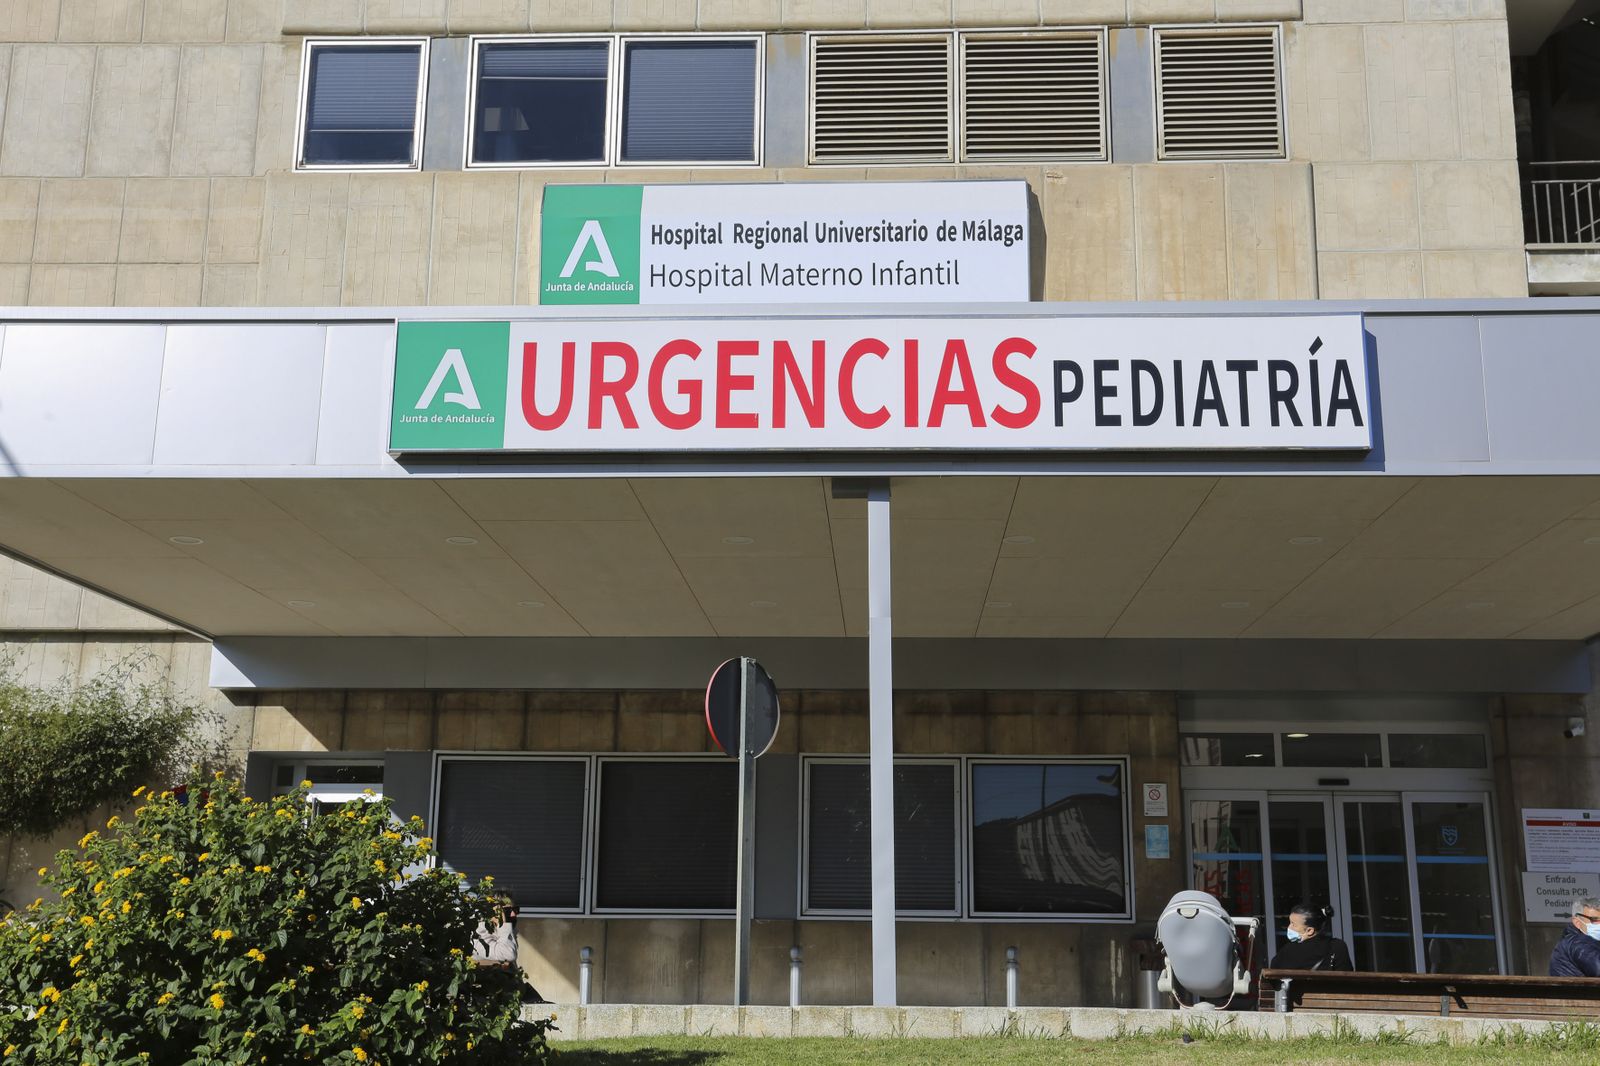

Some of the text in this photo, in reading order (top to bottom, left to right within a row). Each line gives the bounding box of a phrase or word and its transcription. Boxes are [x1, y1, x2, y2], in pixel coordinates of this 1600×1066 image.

[652, 219, 1024, 250] Hospital Regional Universitario de Málaga
[650, 260, 960, 294] Hospital Materno Infantil
[545, 281, 634, 293] Junta de Andalucía
[521, 336, 1364, 431] URGENCIAS PEDIATRÍA
[399, 413, 495, 425] Junta de Andalucía
[1545, 875, 1576, 884] Entrada
[1536, 887, 1588, 896] Consulta PCR
